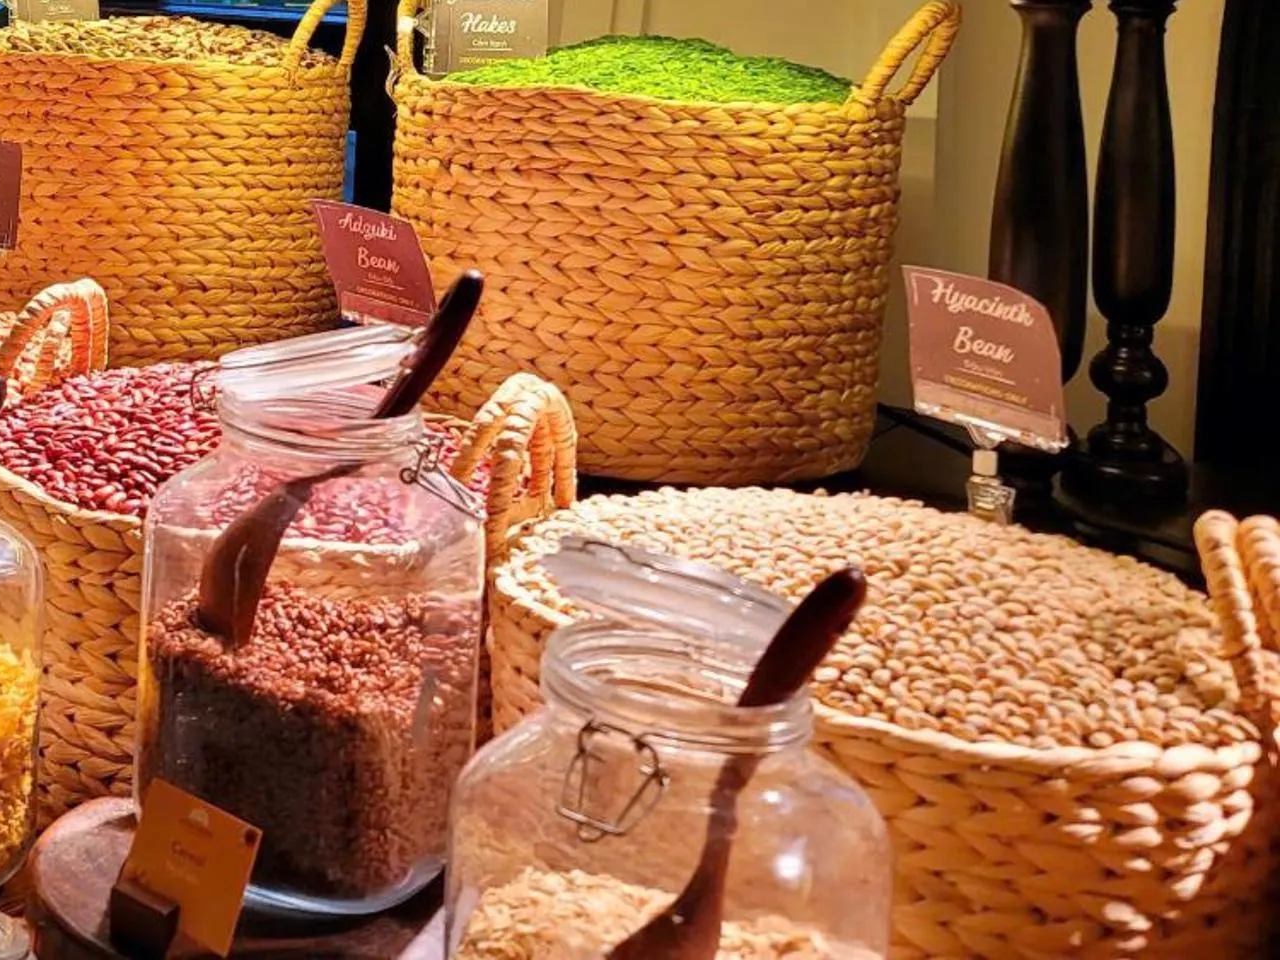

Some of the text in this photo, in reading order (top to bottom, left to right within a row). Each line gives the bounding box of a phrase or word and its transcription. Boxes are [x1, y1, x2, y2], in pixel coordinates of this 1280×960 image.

[358, 246, 400, 274] Bean
[931, 277, 1035, 326] Hyacinth
[953, 326, 1014, 364] Bean
